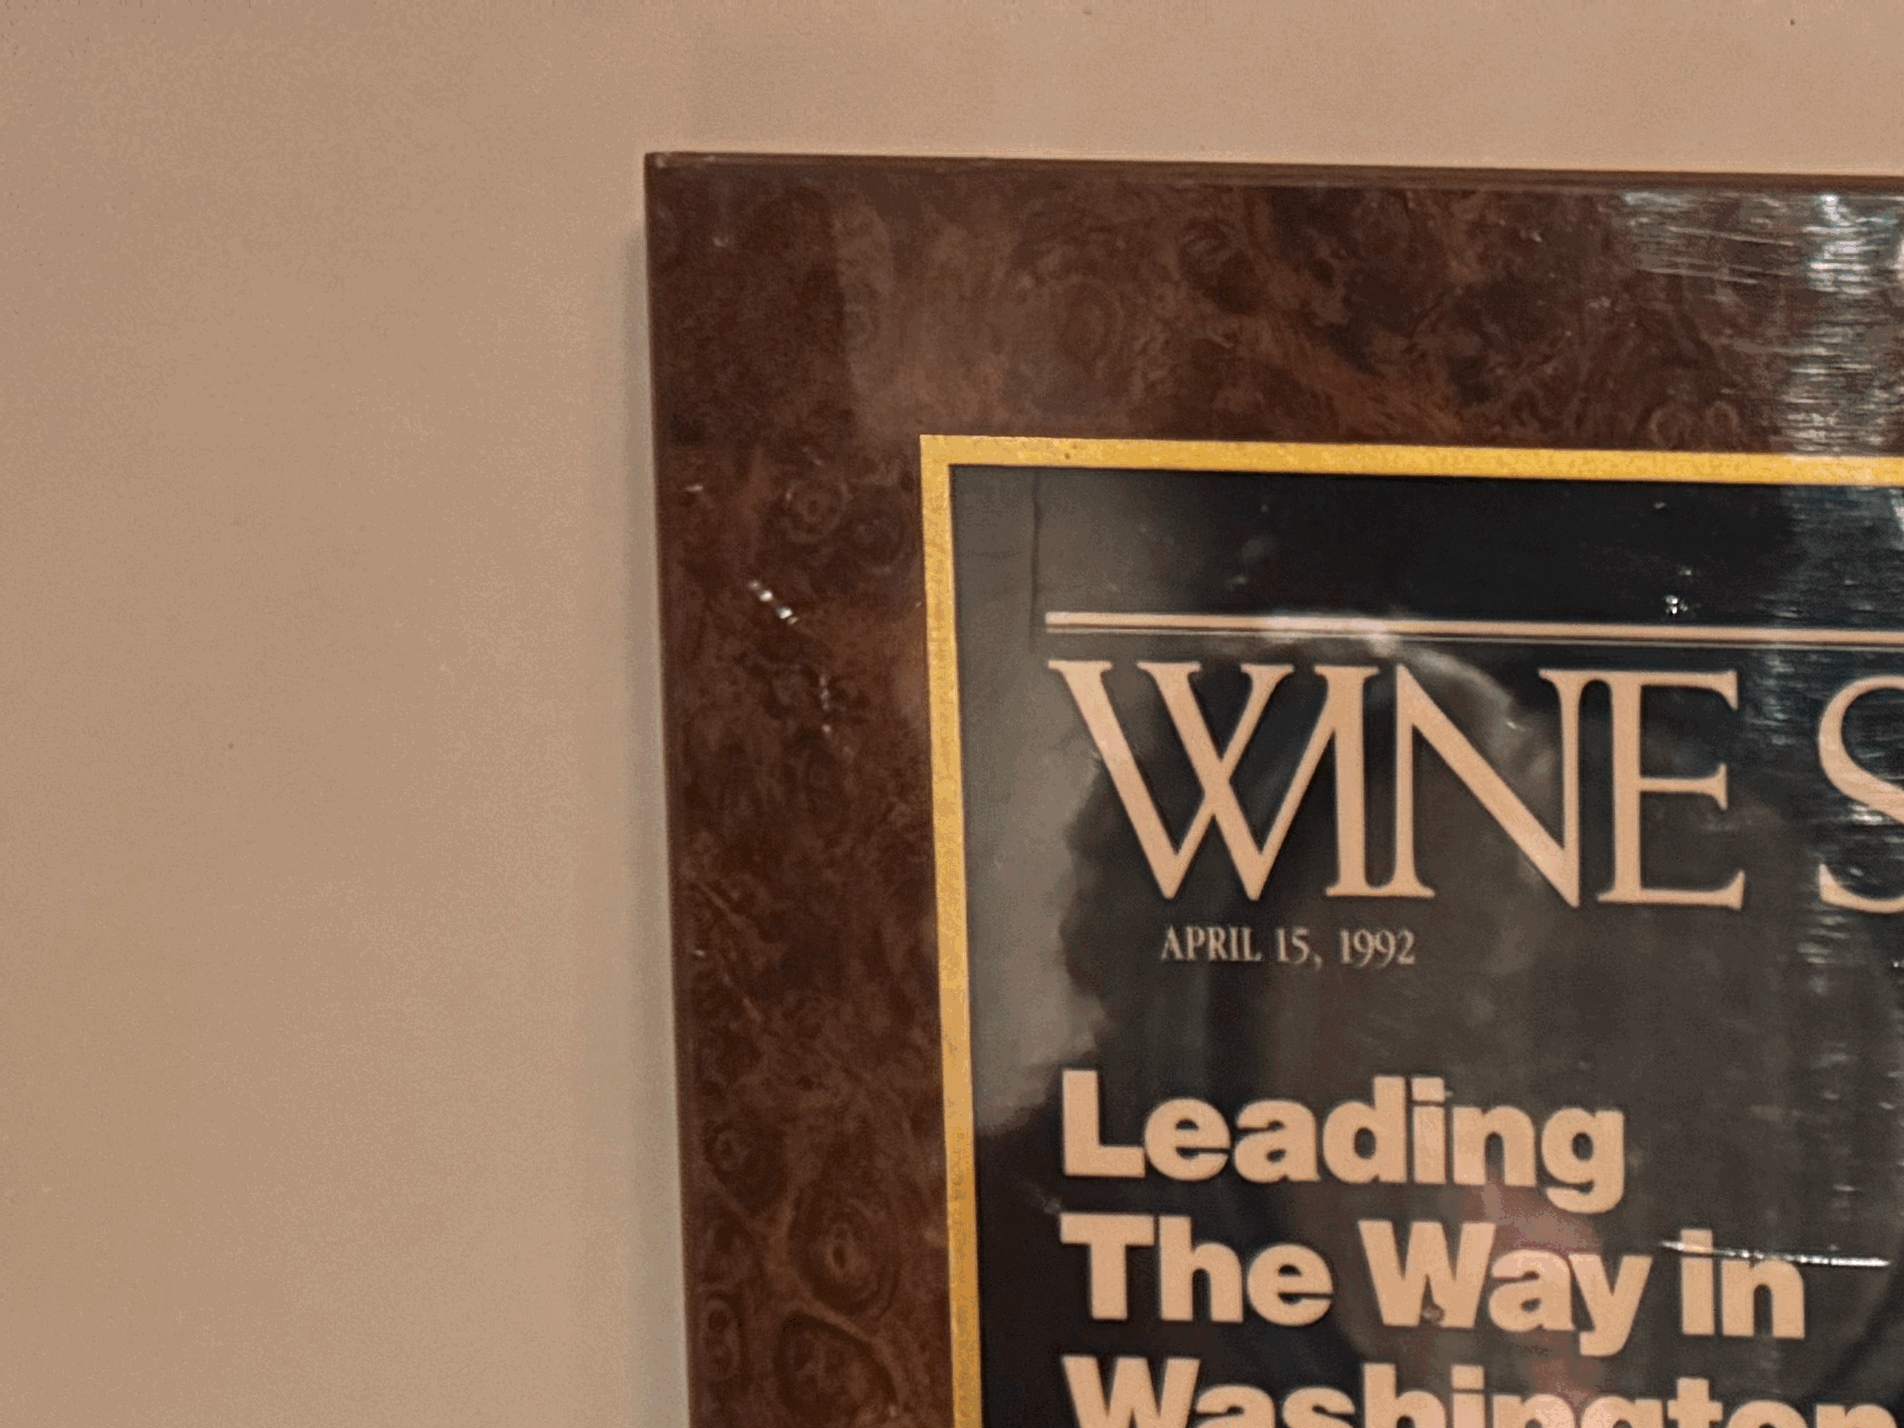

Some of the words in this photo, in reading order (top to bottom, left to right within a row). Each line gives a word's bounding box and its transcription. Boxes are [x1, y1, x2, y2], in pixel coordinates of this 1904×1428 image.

[1047, 659, 1745, 907] WINE
[1160, 925, 1264, 962] APRIL
[1276, 927, 1322, 971] 15,
[1340, 928, 1415, 967] 1992
[1061, 1069, 1625, 1213] Leading
[1059, 1212, 1333, 1327] The
[1358, 1219, 1652, 1356] Way
[1678, 1228, 1806, 1339] in
